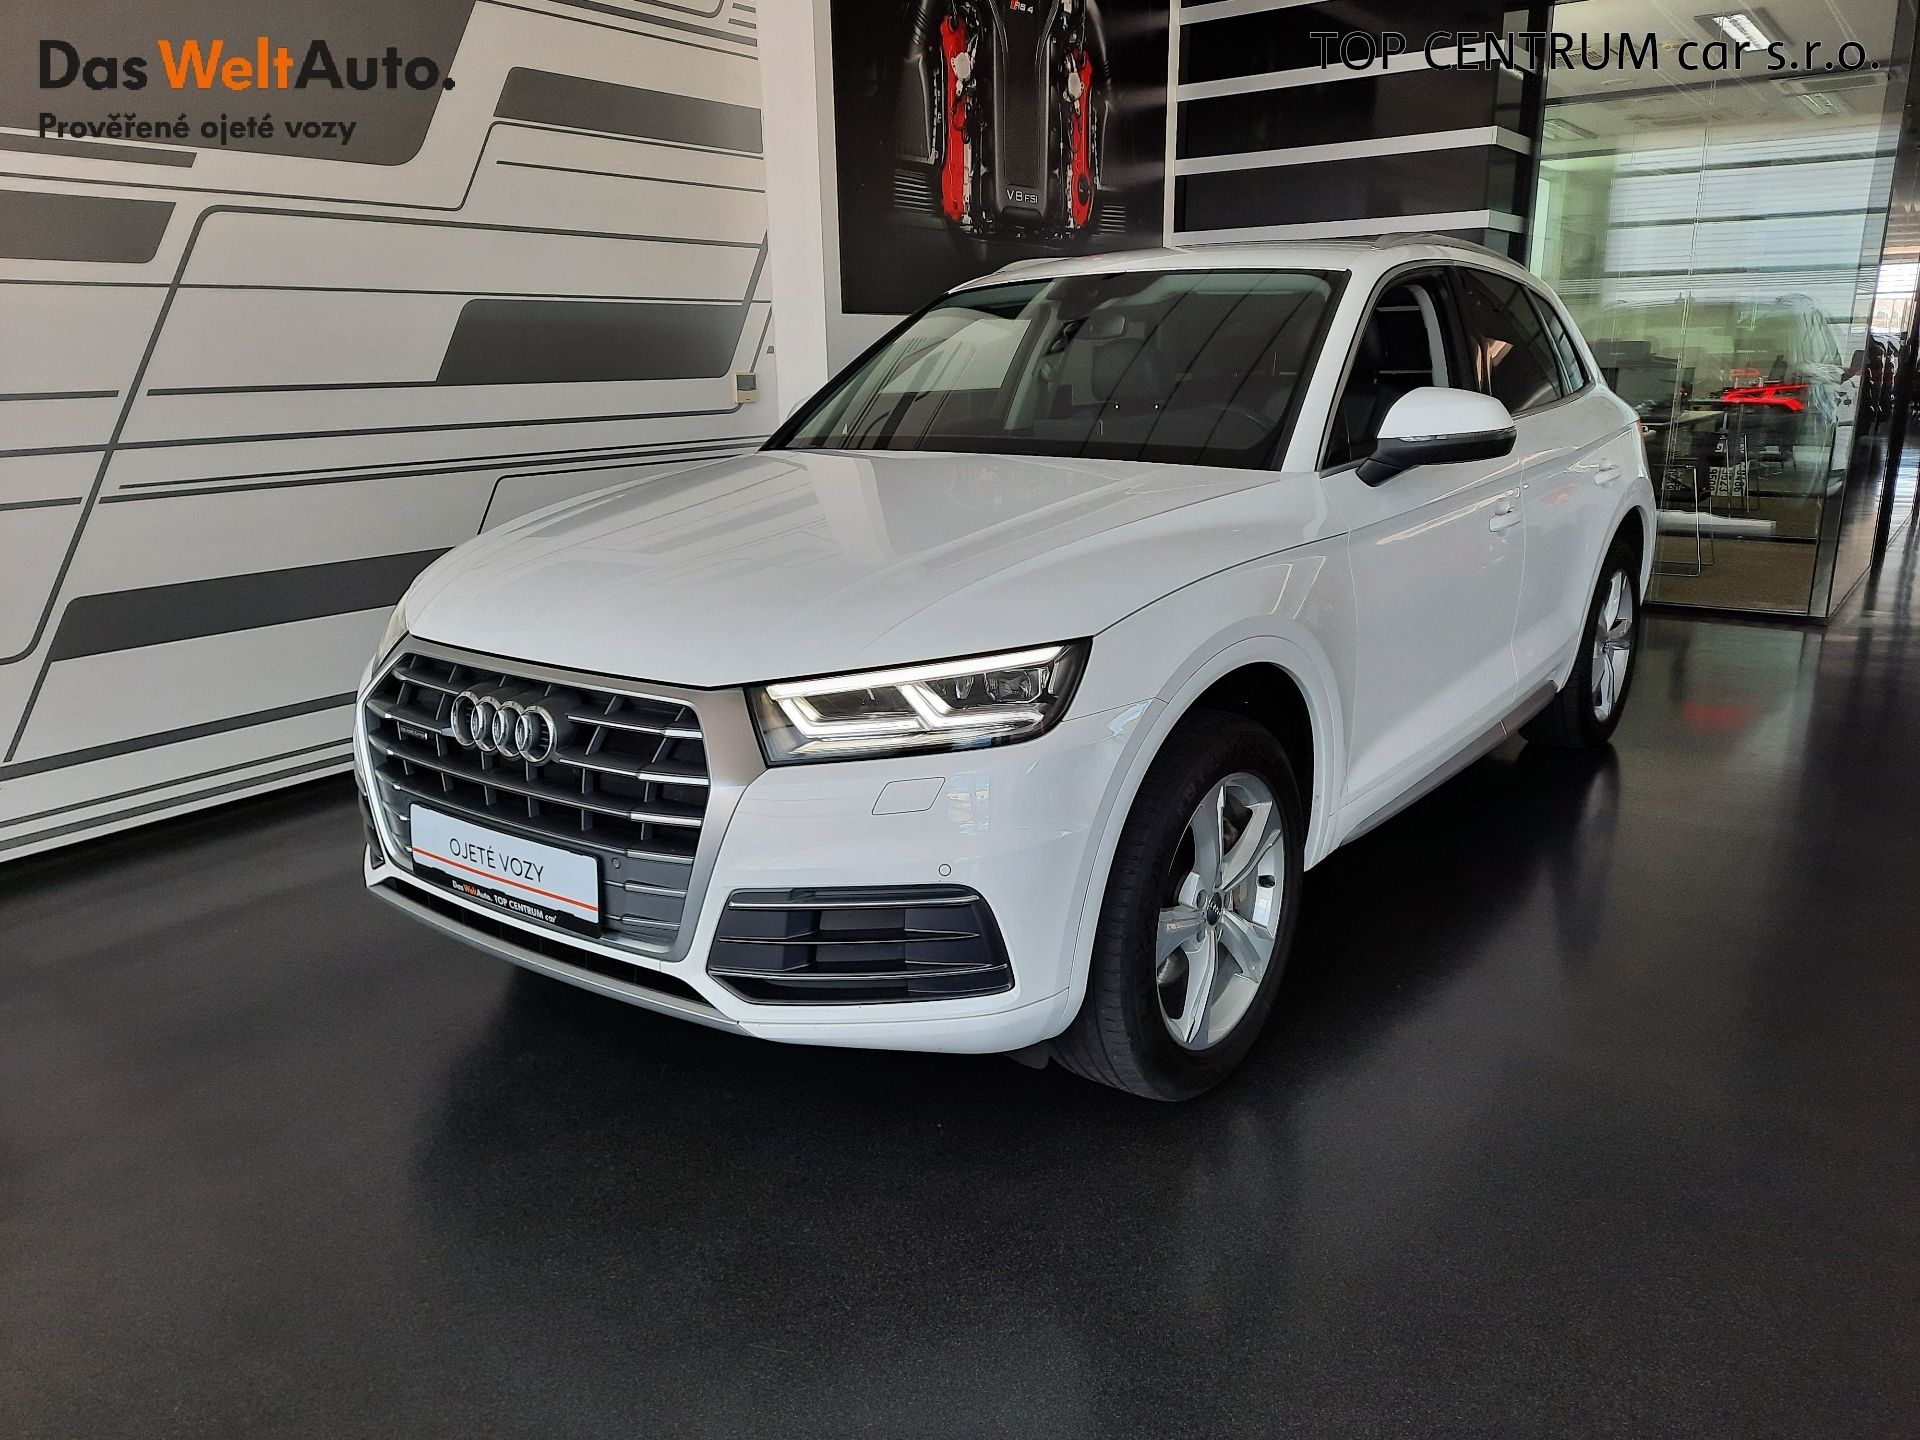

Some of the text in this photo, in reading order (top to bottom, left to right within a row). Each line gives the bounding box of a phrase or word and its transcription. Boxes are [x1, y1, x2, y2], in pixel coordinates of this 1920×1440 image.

[1006, 189, 1038, 204] V8 FSI
[450, 838, 544, 883] OJETÉ VOZY
[494, 895, 508, 907] TOP
[509, 900, 544, 919] CENTRUM
